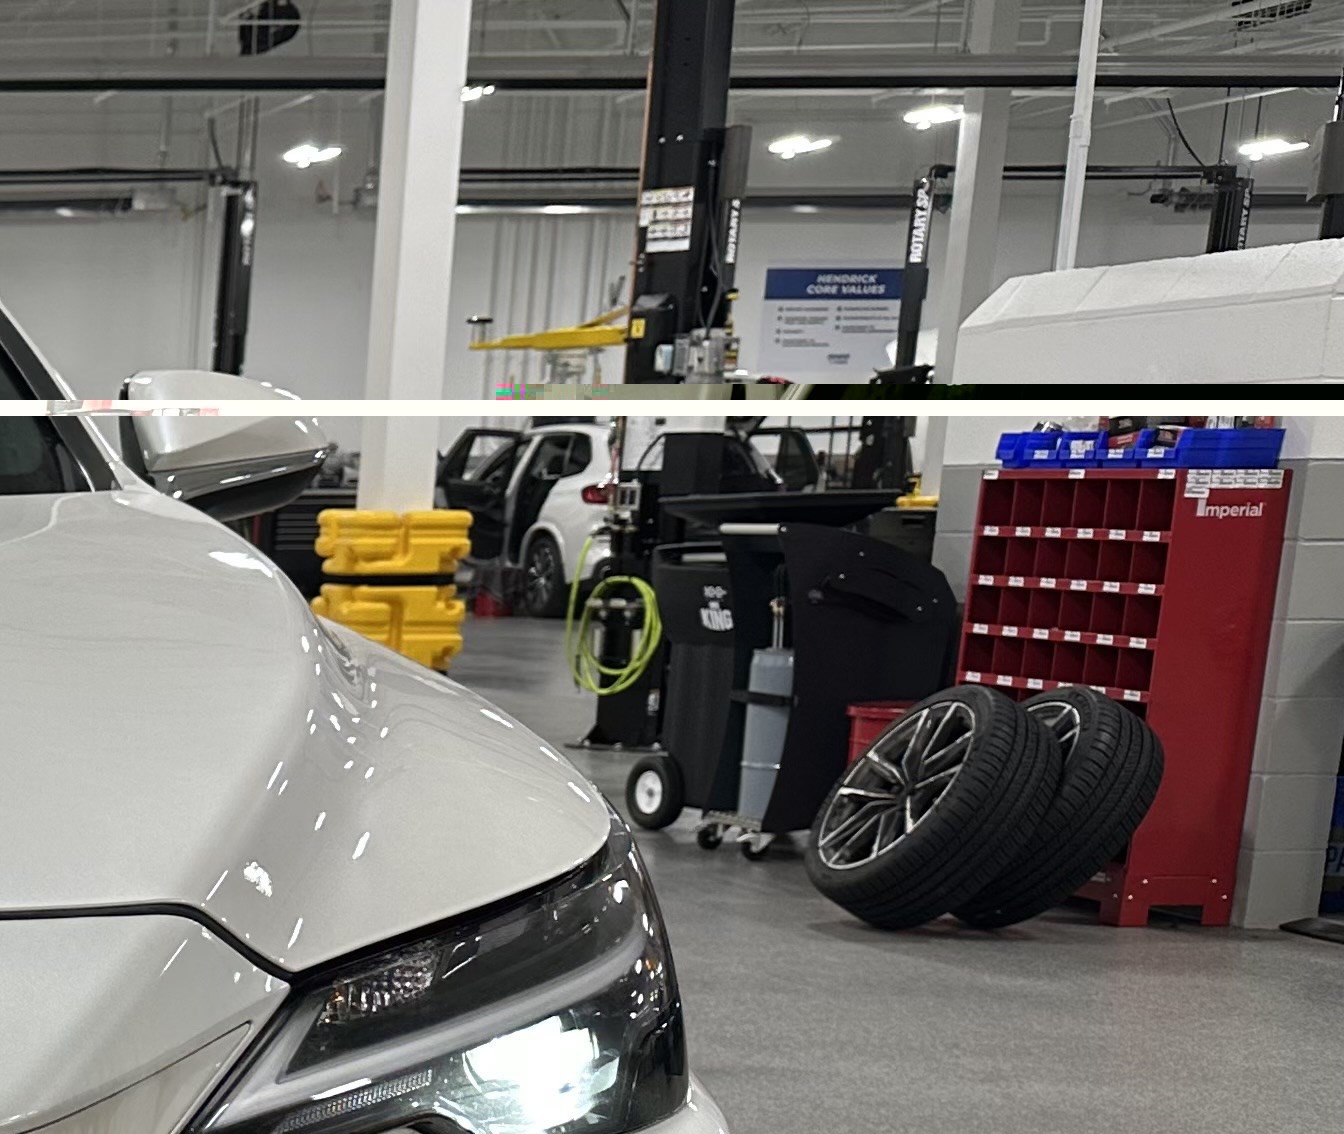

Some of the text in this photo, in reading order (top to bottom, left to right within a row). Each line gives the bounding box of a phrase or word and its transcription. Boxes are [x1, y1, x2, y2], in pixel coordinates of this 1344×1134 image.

[909, 208, 927, 263] ROTARY
[816, 274, 878, 283] HENDRICK
[806, 284, 886, 295] CORE VALUES
[1196, 498, 1264, 519] Imperial
[700, 607, 734, 631] KING
